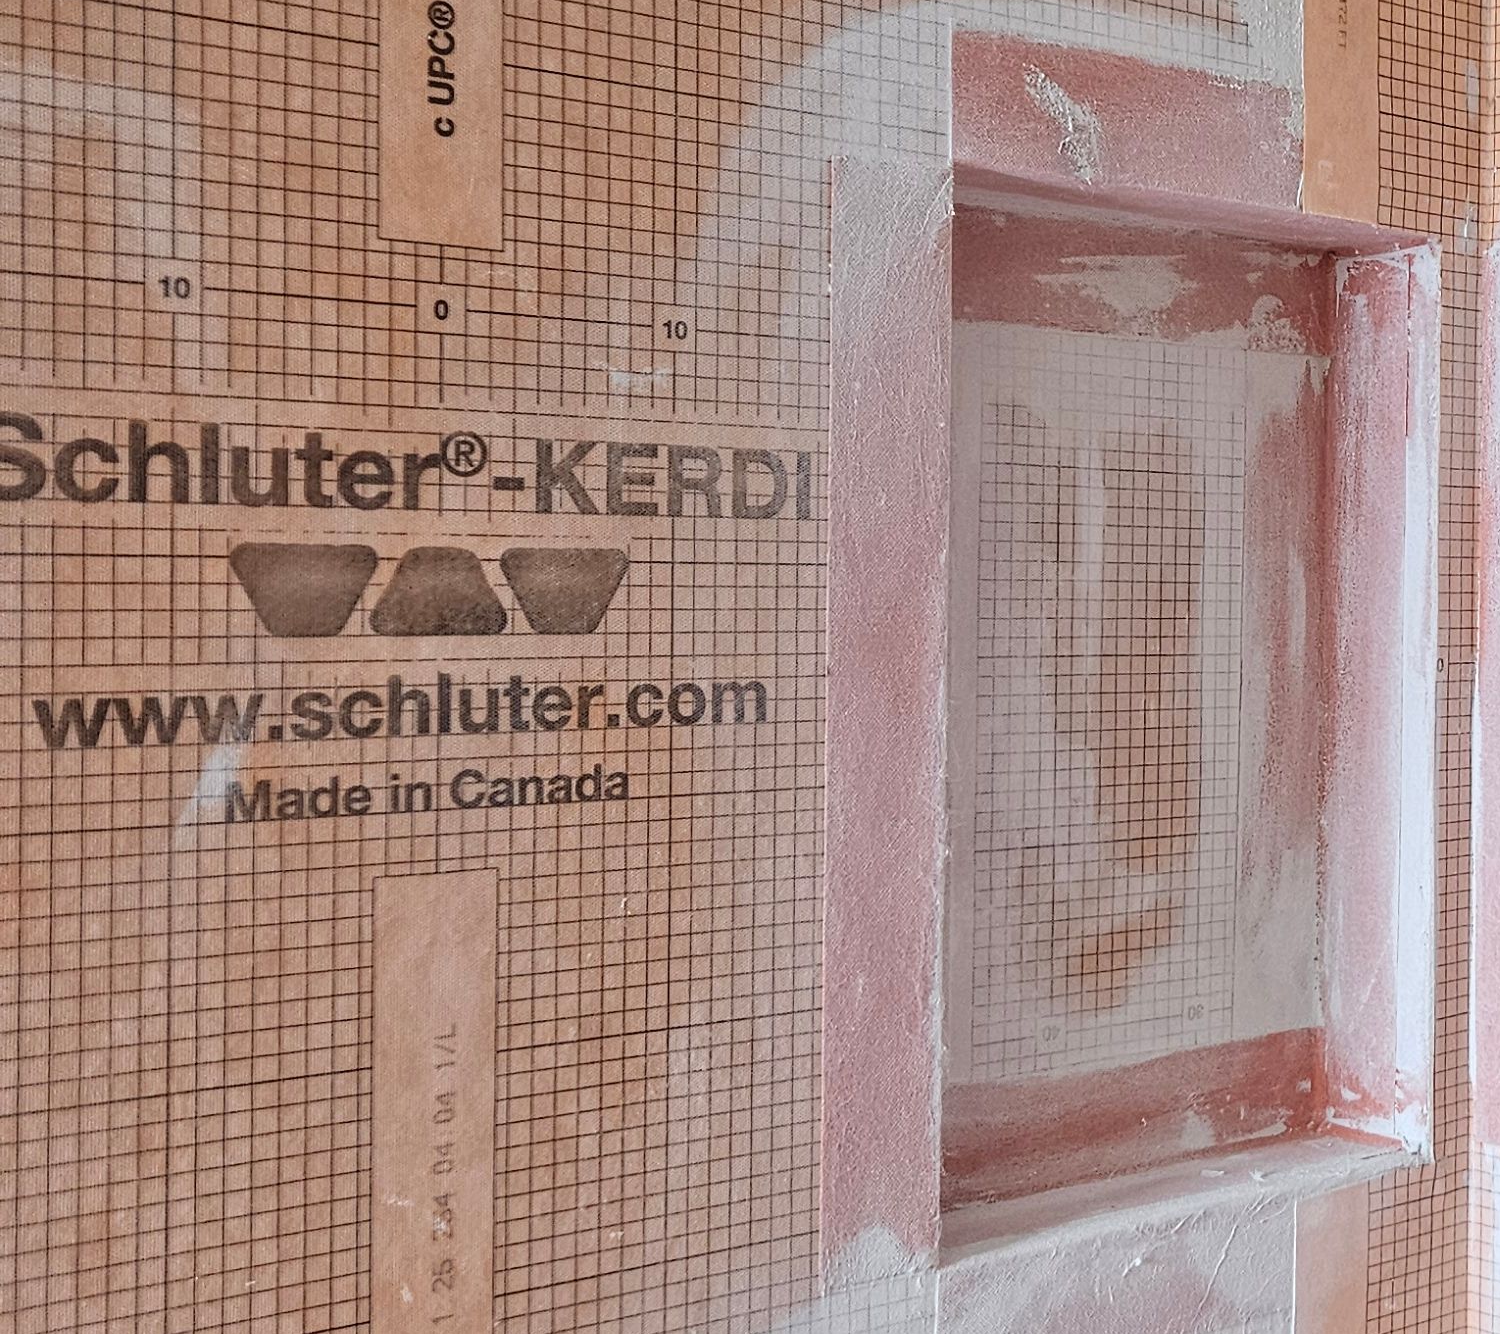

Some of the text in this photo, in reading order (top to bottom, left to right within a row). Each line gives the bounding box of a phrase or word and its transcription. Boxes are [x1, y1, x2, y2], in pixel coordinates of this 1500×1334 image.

[434, 117, 455, 137] c
[157, 276, 688, 340] 10 0 10
[32, 673, 768, 748] www.schluter.com
[225, 764, 629, 822] Made in Canada
